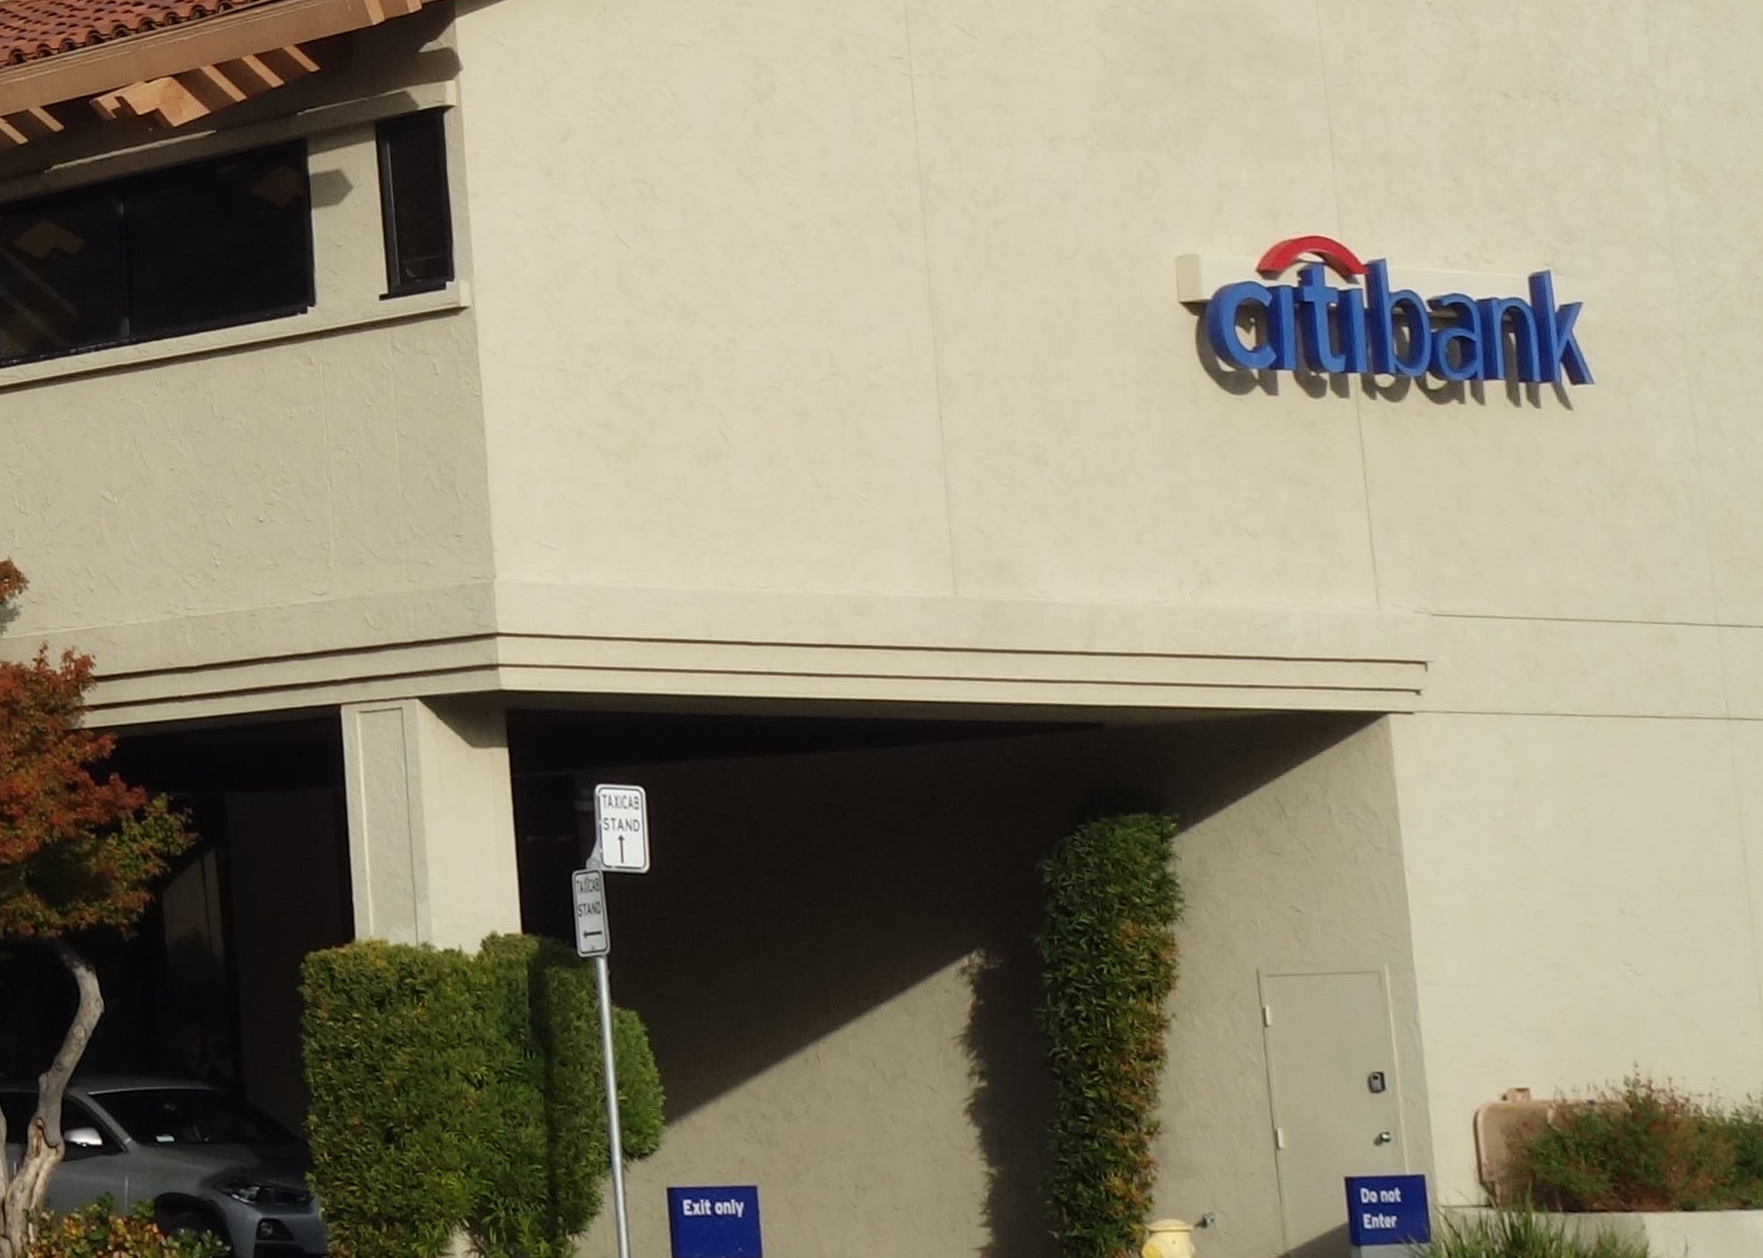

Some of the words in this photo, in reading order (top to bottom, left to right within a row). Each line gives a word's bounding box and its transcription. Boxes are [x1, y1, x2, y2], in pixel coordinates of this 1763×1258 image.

[1205, 236, 1595, 385] citibank
[602, 794, 640, 810] TAXICAB
[603, 818, 640, 832] STAND
[576, 876, 601, 893] TAXICAB
[578, 901, 601, 917] STAND
[1360, 1187, 1378, 1204] Do
[1380, 1187, 1402, 1203] not
[683, 1199, 712, 1216] Exit
[714, 1199, 744, 1218] only
[1363, 1213, 1397, 1230] Enter
